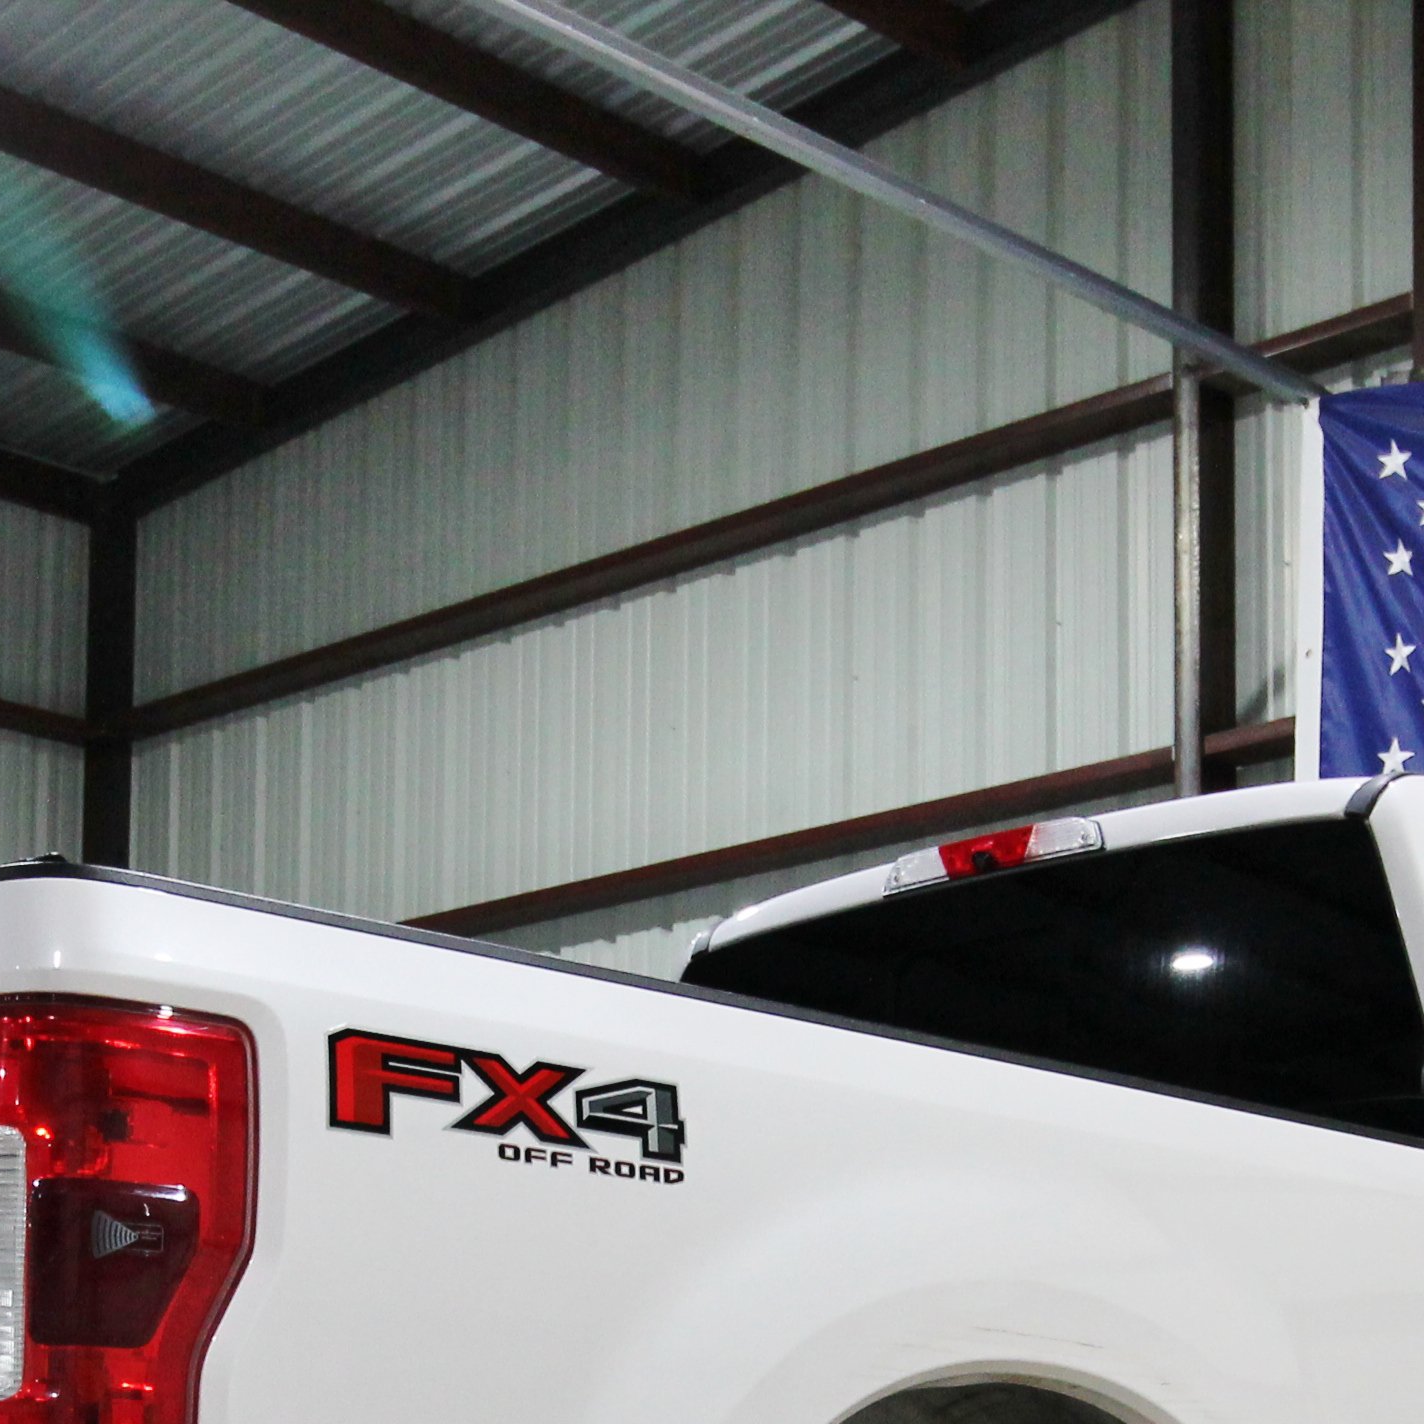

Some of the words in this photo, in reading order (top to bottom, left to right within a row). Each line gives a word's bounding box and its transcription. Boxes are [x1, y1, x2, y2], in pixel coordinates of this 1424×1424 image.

[327, 1027, 686, 1164] FX4
[498, 1143, 573, 1168] OFF
[589, 1156, 685, 1184] ROAD
